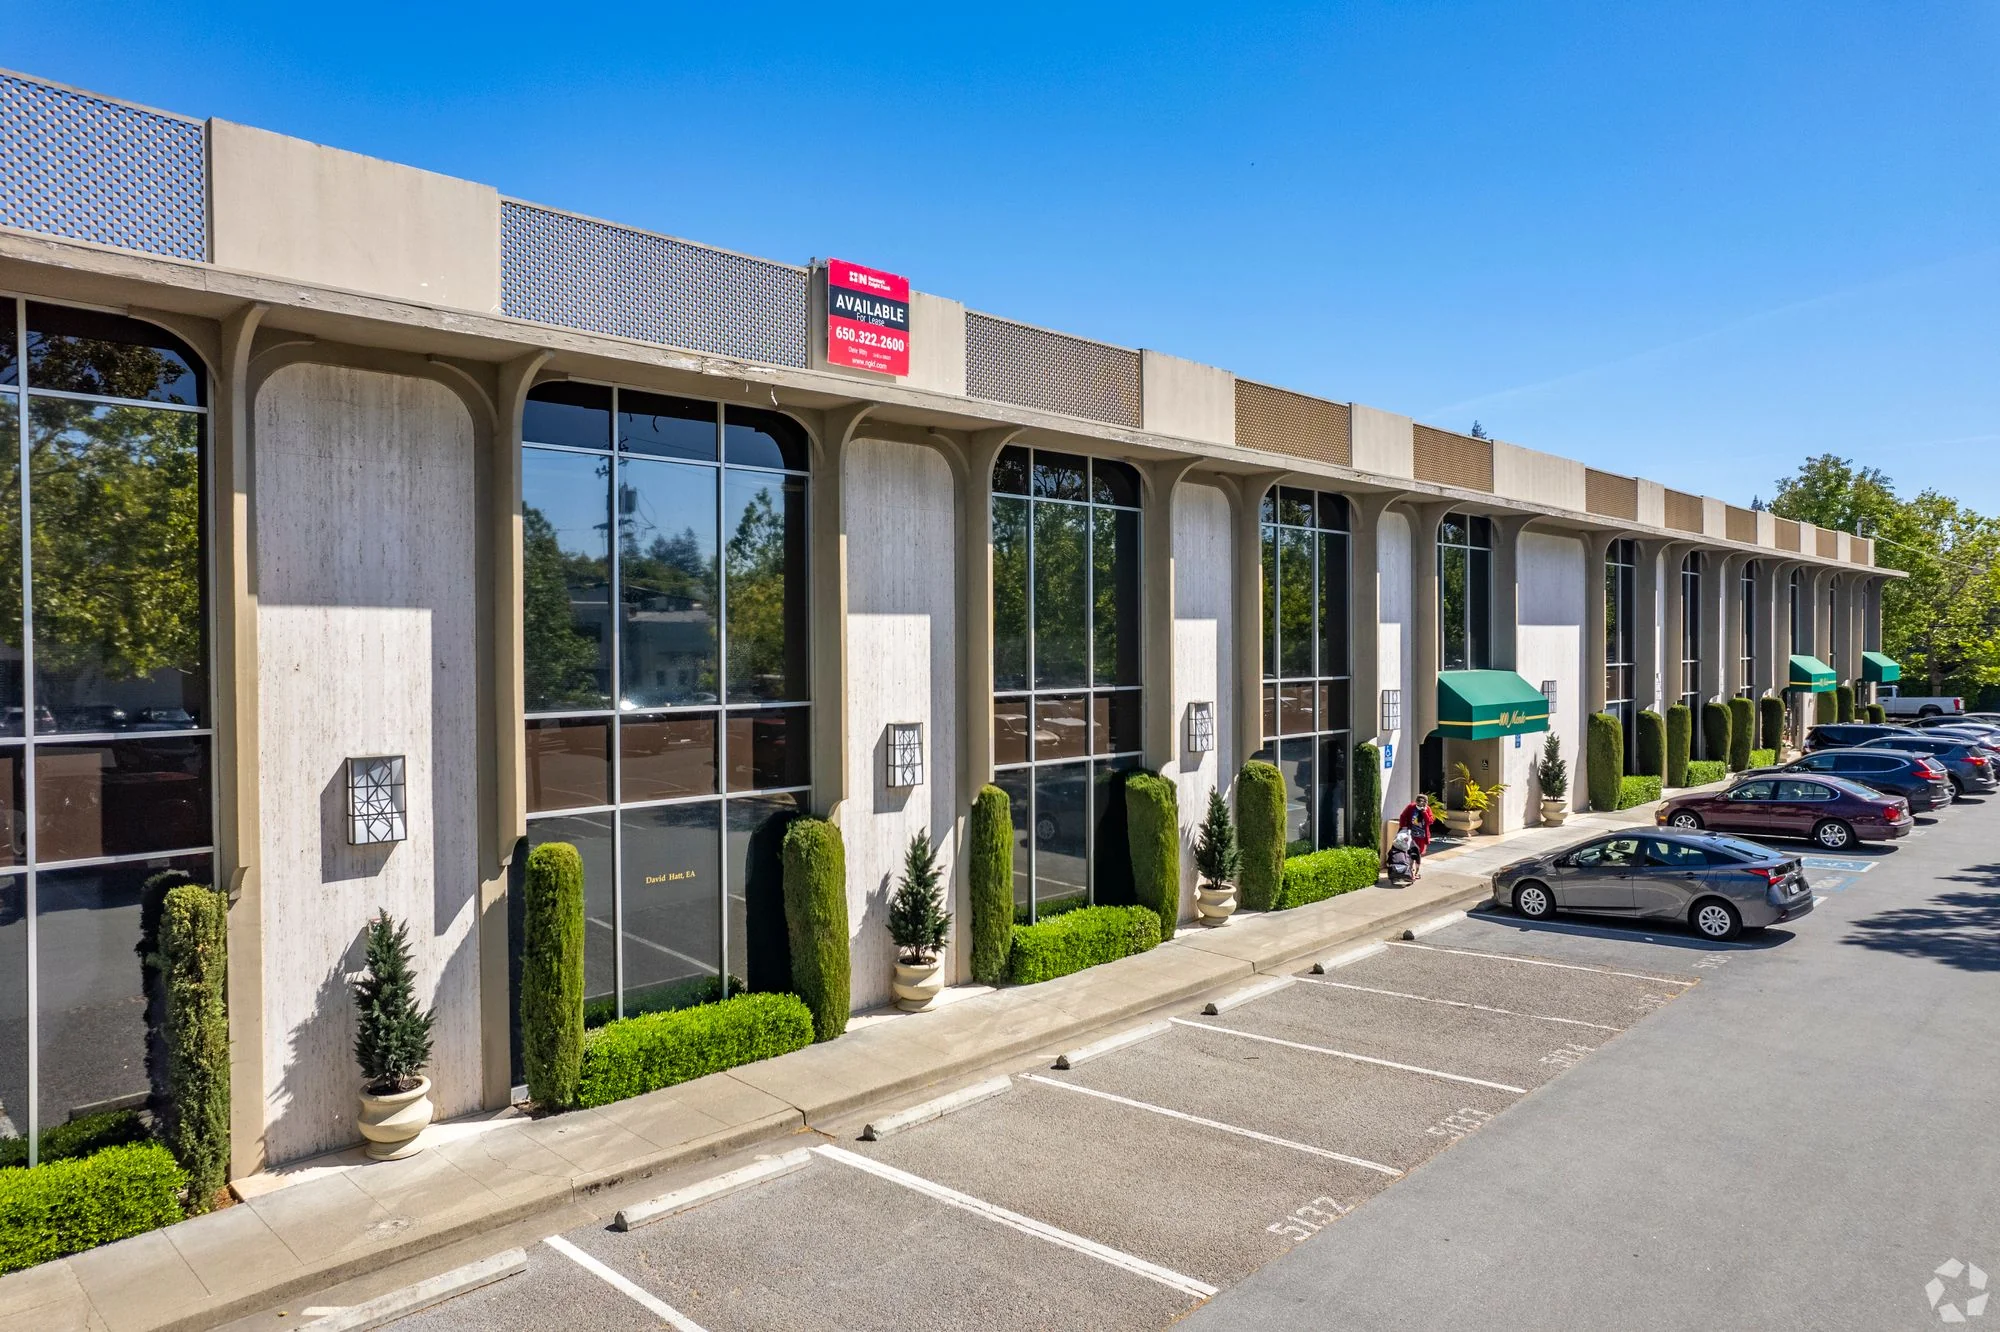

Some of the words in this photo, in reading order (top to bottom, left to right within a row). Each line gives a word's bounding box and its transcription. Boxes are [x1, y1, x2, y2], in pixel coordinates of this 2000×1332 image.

[836, 294, 904, 323] AVAILABLE
[856, 312, 866, 323] For
[868, 315, 885, 327] Lease
[836, 326, 904, 352] 650.322.2600
[645, 873, 666, 884] David
[685, 869, 696, 878] EA
